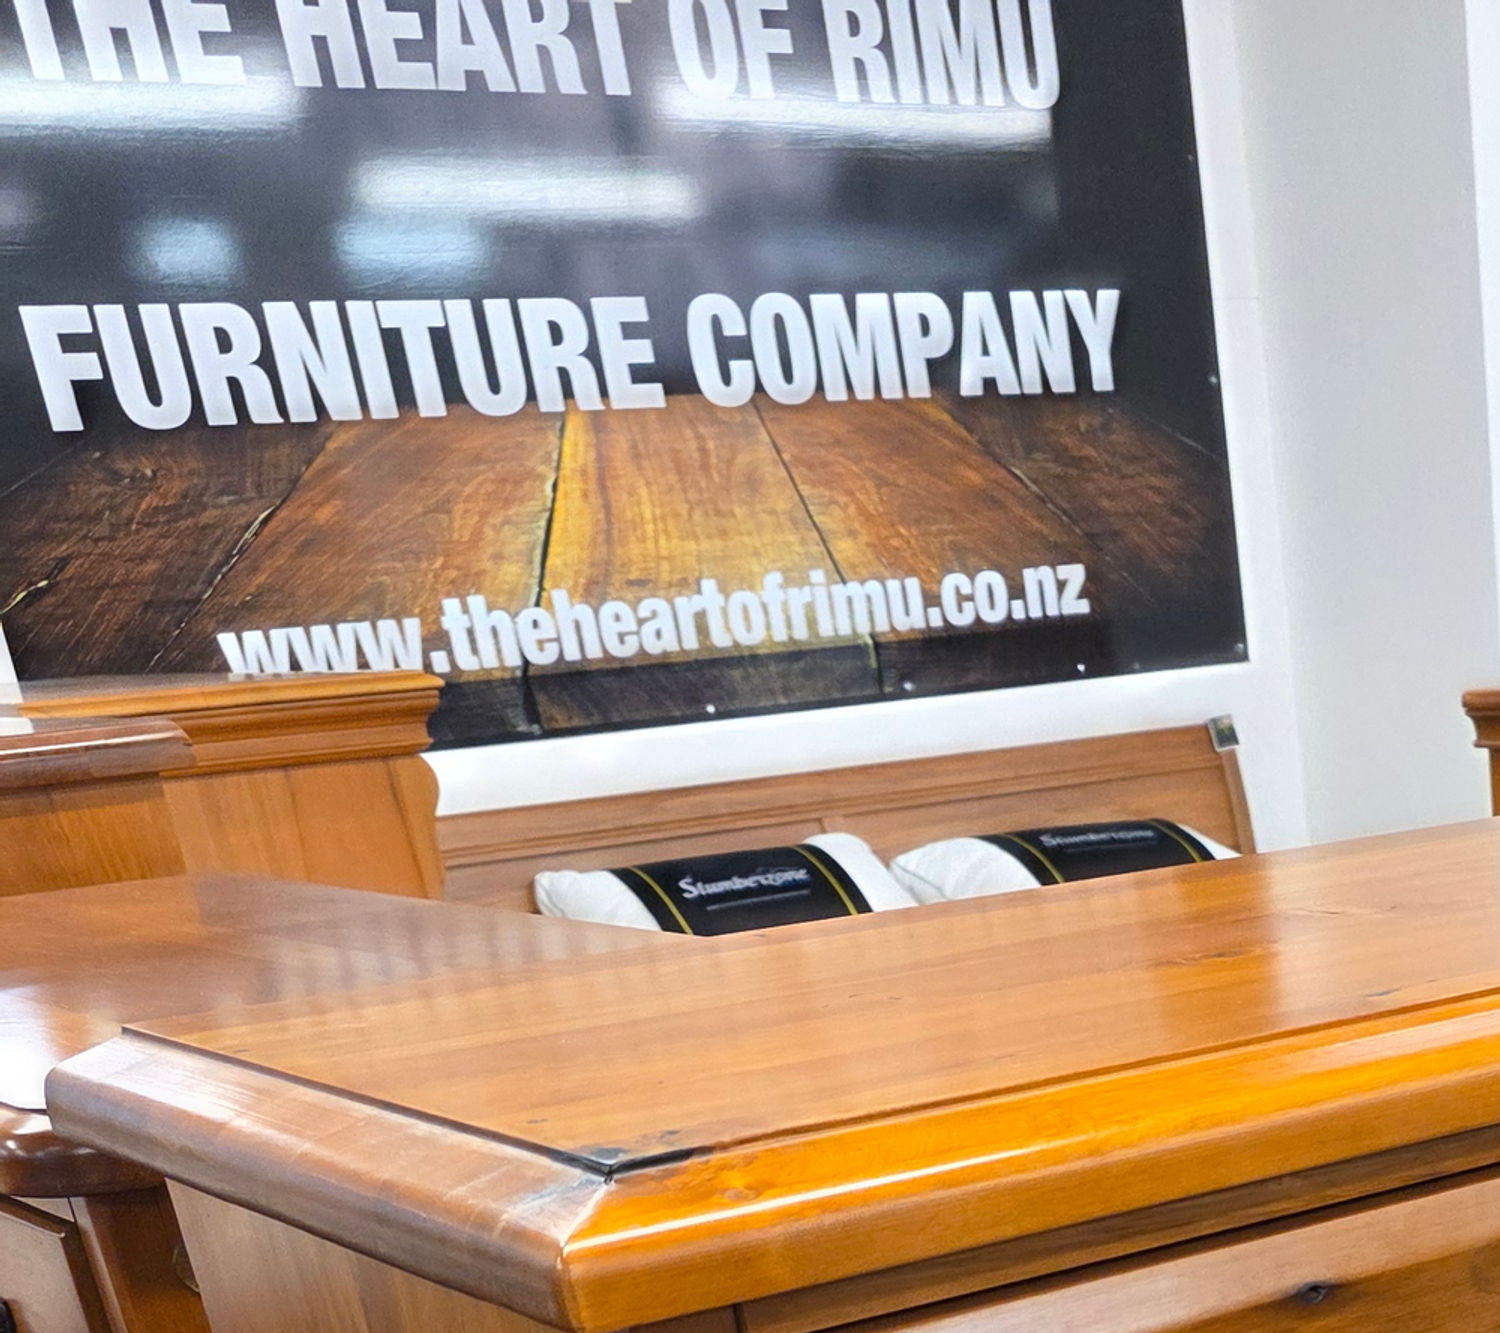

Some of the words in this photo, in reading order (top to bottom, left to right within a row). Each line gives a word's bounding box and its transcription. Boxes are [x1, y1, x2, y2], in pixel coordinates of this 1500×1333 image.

[16, 0, 246, 85] THE
[275, 0, 632, 96] HEART
[668, 0, 794, 101] OF
[823, 0, 1060, 109] RIMU
[19, 296, 667, 431] FURNITURE
[687, 289, 1120, 408] COMPANY
[216, 562, 1091, 675] www.theheartofrimu.co.nz
